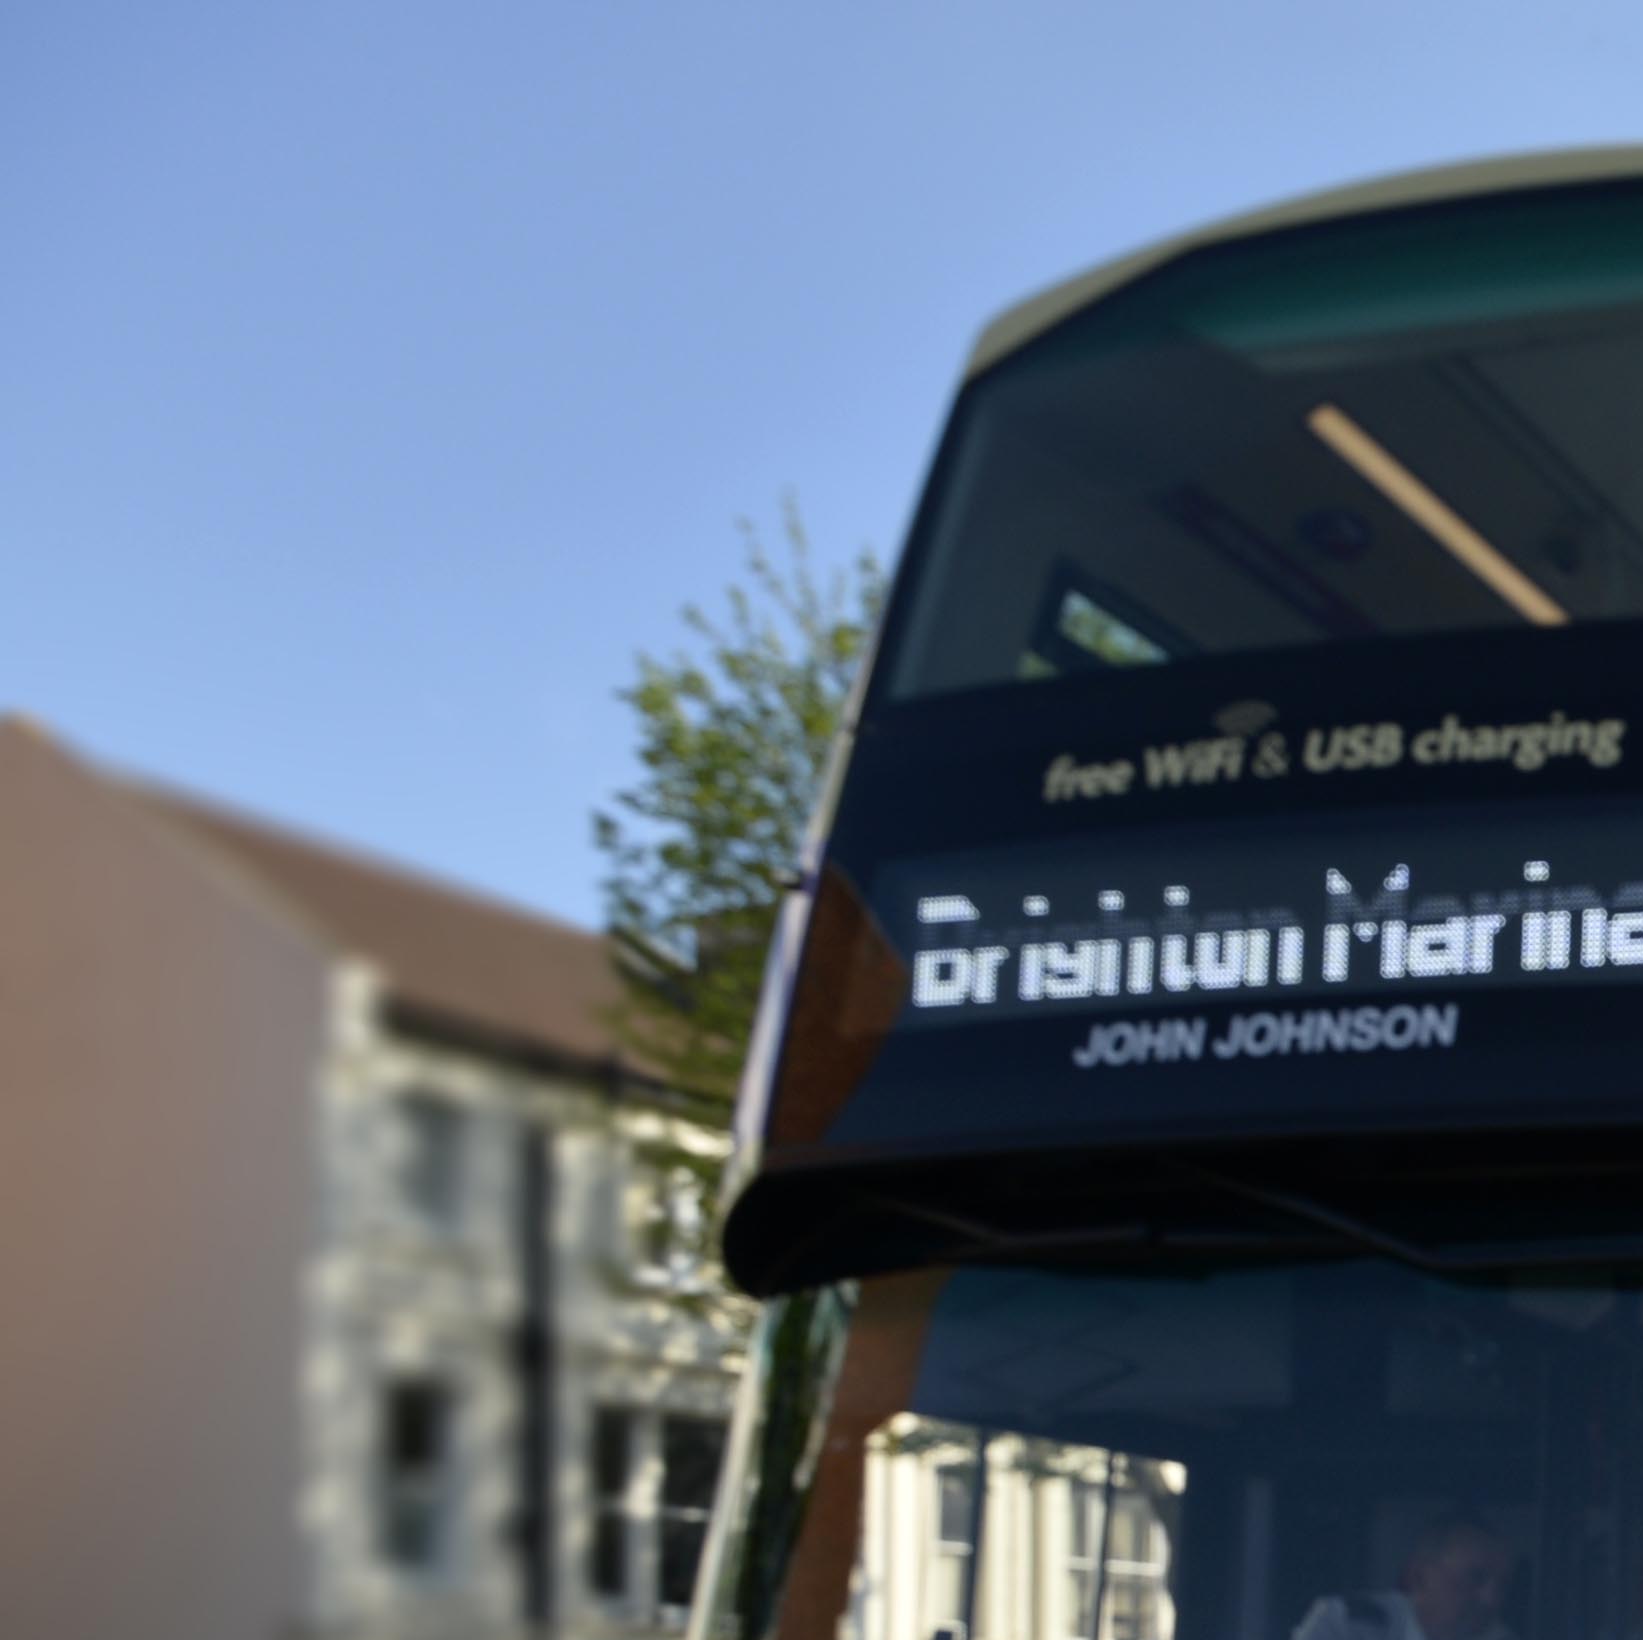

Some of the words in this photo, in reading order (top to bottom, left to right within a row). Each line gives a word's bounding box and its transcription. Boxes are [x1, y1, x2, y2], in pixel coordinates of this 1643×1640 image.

[1043, 755, 1134, 802] free
[1143, 737, 1243, 788] WiFi
[1253, 733, 1289, 778] &
[1303, 722, 1403, 773] USB
[1412, 712, 1625, 768] charging
[1072, 1019, 1204, 1069] JOHN
[1212, 1005, 1460, 1062] JOHNSON
